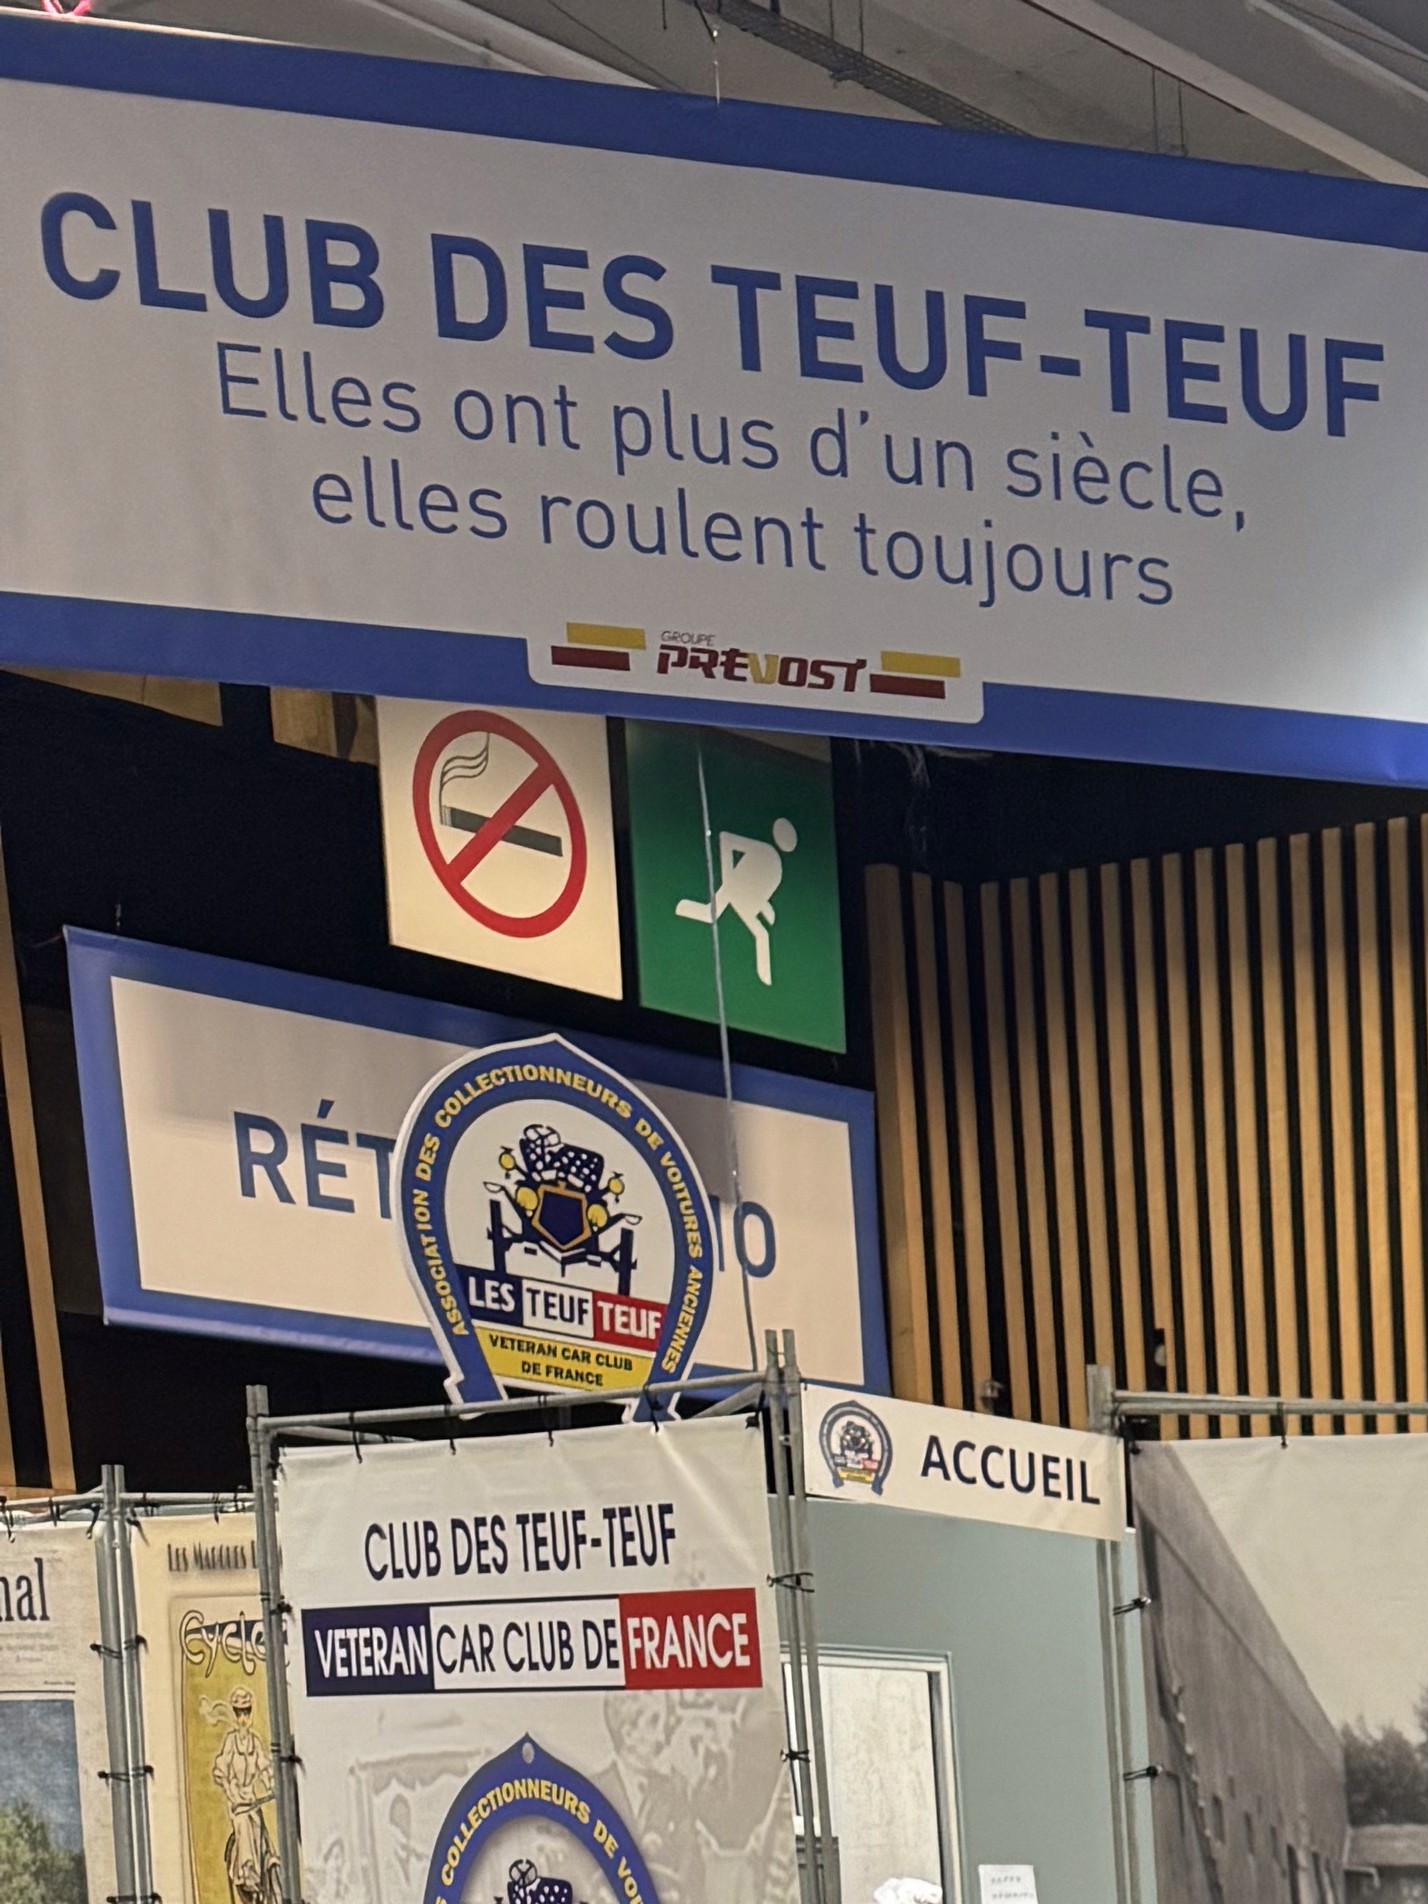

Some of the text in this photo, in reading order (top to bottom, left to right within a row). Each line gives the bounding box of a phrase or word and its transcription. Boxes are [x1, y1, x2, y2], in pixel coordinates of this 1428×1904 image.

[40, 190, 1385, 438] CLUB DES TEUF-TEUF
[216, 343, 421, 434] Elles
[453, 384, 583, 452] ont
[612, 384, 780, 479] plus
[1005, 430, 1249, 532] siècle,
[311, 457, 1176, 610] elles roulent toujours
[660, 630, 716, 647] GROUPE
[435, 1064, 633, 1128] COLLECTIONNEURS
[233, 1099, 394, 1221] RÉT
[416, 1133, 440, 1181] DES
[635, 1118, 664, 1150] DE
[659, 1151, 702, 1259] VOITURES
[468, 1276, 662, 1339] LES TEUF TEUF
[662, 1265, 703, 1375] ANCIENNES
[489, 1334, 633, 1371] VETERAN CAR CLUB
[521, 1361, 604, 1387] DE FRANCE
[920, 1434, 1101, 1506] ACCUEIL
[365, 1503, 677, 1581] CLUB DES TEUF-TEUF
[314, 1612, 751, 1678] VETERAN CAR CLUB DE FRANCE
[441, 1778, 590, 1886] COLLECTIONNEURS
[593, 1819, 619, 1858] DE
